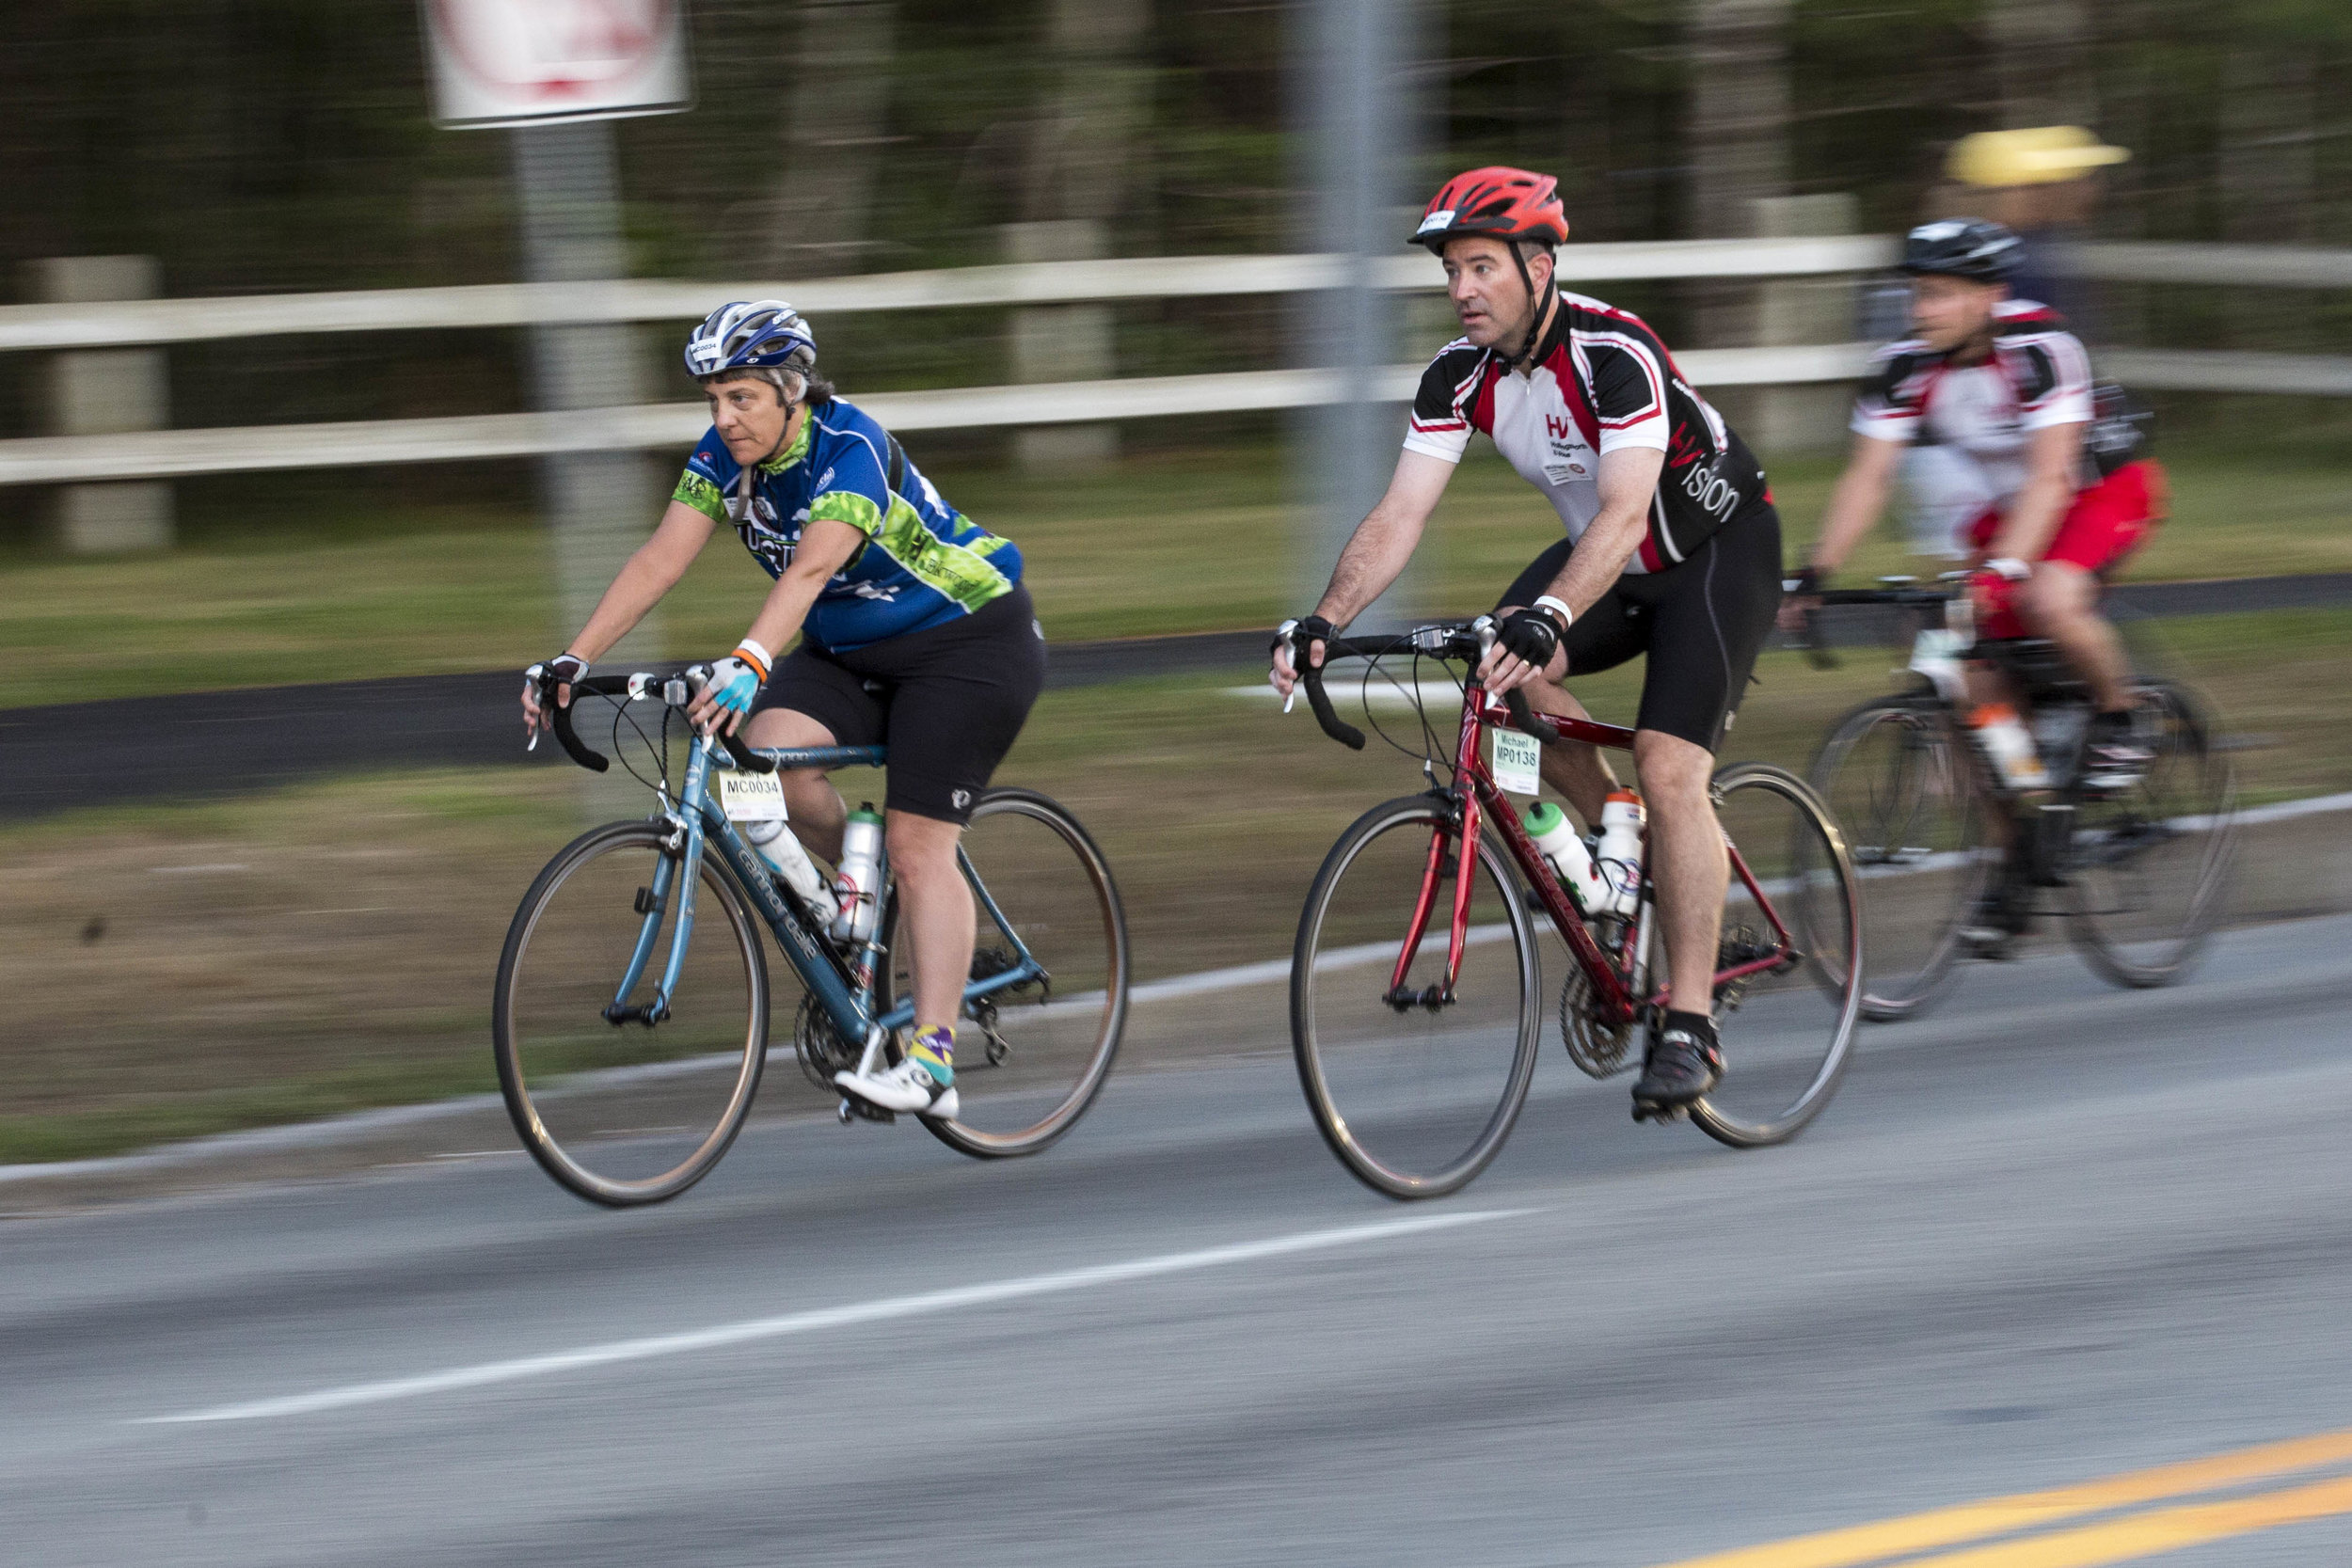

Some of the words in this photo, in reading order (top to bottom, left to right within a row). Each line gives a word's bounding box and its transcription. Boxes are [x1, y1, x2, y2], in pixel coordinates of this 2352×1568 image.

[1502, 734, 1529, 748] Michael
[1497, 745, 1536, 767] MP0138
[728, 780, 778, 793] MC0034
